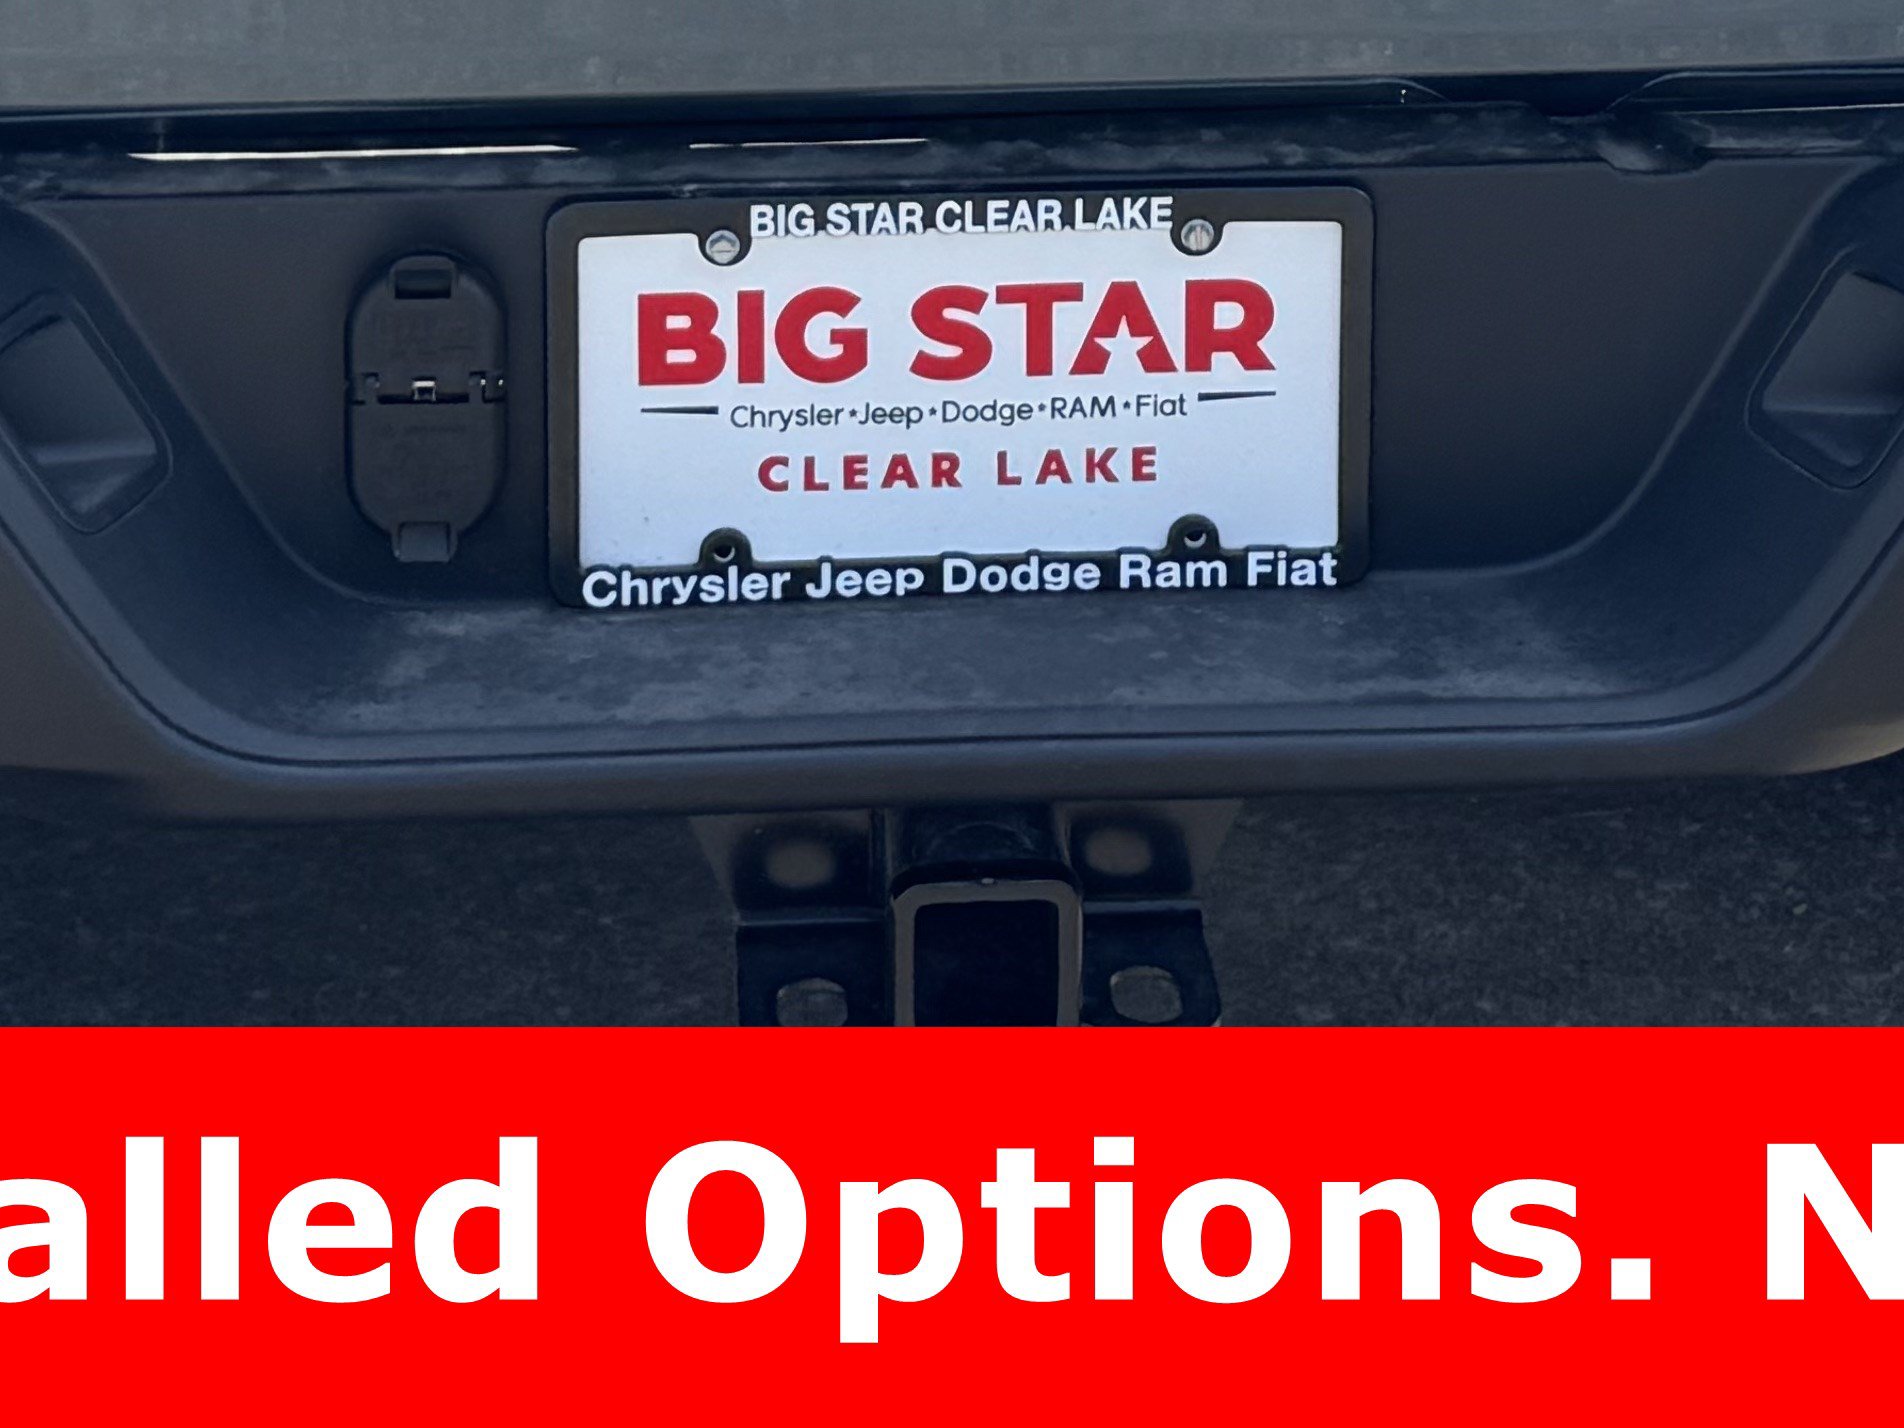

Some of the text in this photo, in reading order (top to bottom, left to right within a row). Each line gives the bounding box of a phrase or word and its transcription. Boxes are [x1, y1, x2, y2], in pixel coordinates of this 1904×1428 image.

[749, 195, 1174, 237] BIG STAR CLEAR LAKE
[637, 278, 1278, 387] BIG STAR
[757, 446, 1158, 493] CLEAR LAKE
[581, 549, 1339, 608] Chrysler Jeep Dodge Ram Fiat
